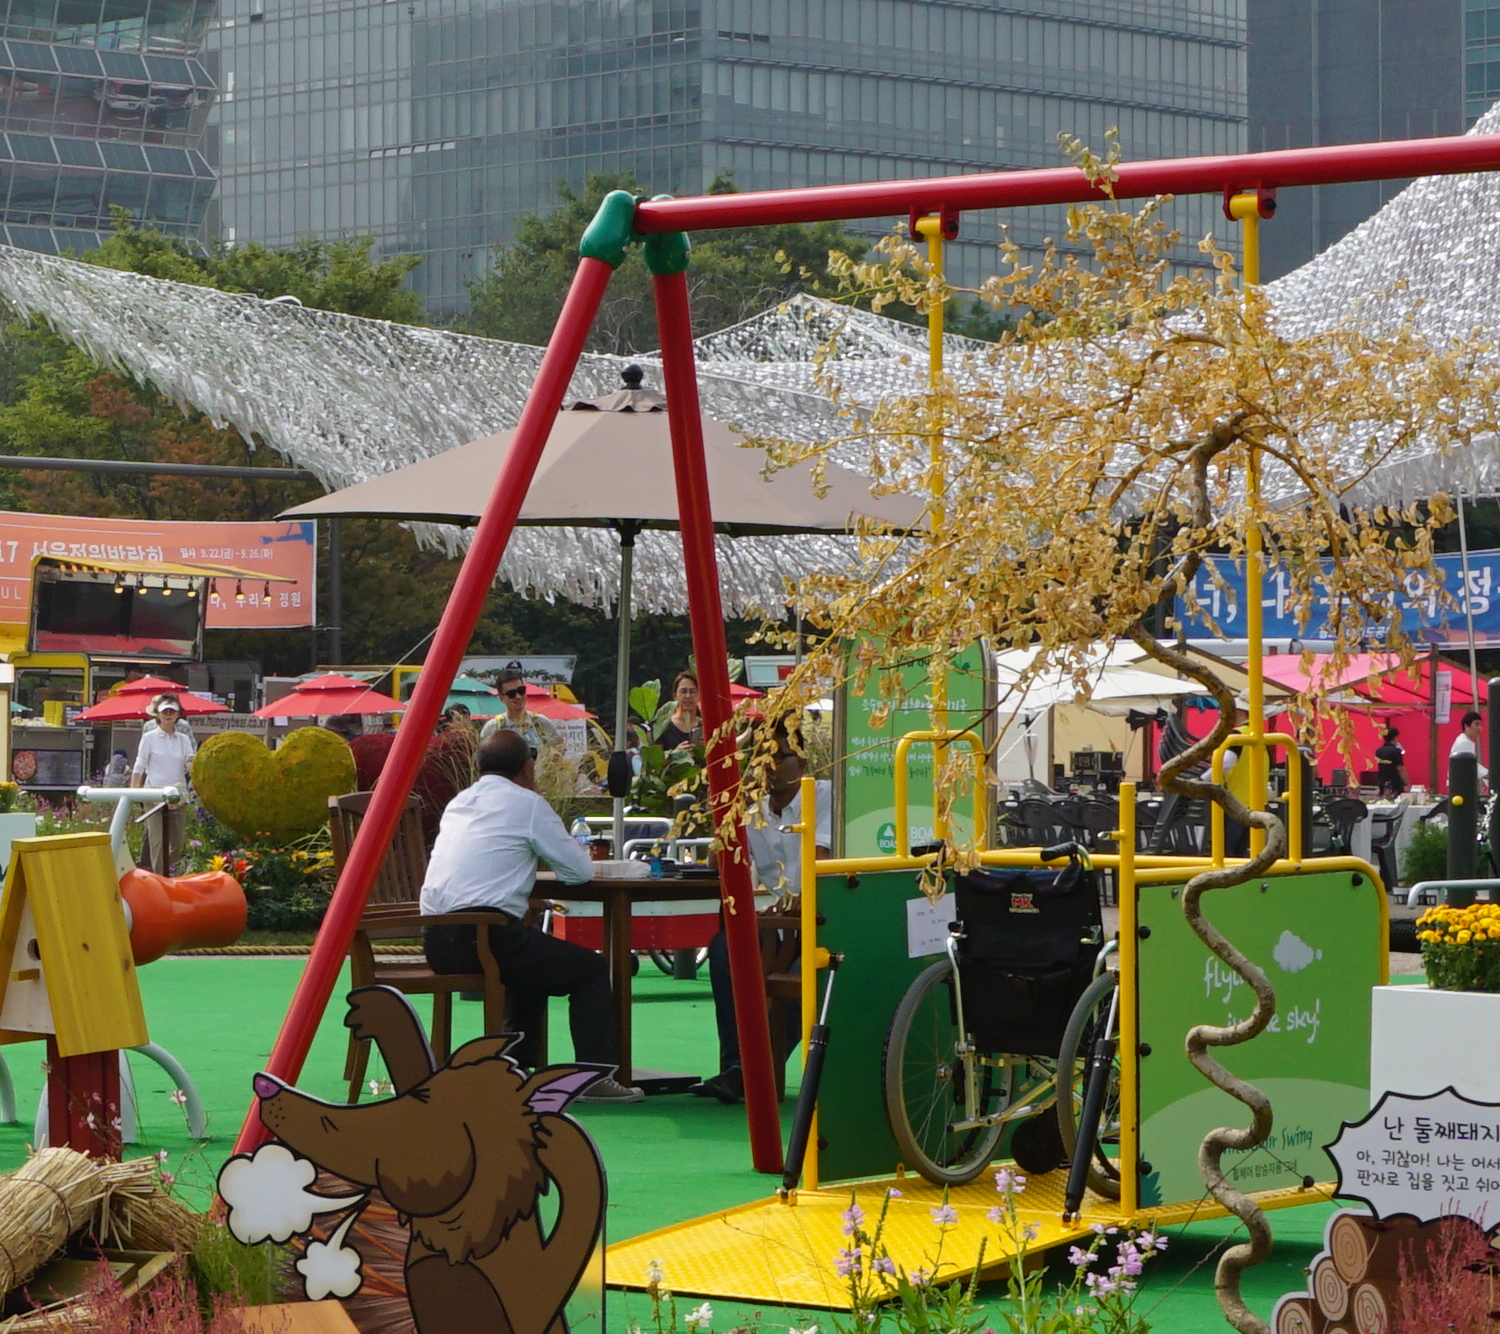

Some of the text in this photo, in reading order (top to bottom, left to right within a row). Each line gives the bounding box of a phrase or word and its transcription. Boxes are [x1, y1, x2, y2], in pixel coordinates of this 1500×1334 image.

[280, 592, 301, 607] 정원
[911, 826, 935, 840] BOA
[1286, 998, 1320, 1044] sky!
[1282, 1125, 1313, 1151] Swing
[1384, 1116, 1403, 1142] 난
[1356, 1150, 1376, 1166] 아,
[1381, 1149, 1431, 1168] 귀찮아!
[1437, 1153, 1466, 1171] 나는
[1471, 1156, 1500, 1171] 어서
[1356, 1169, 1400, 1187] 판자로
[1407, 1171, 1434, 1191] 집을
[1441, 1174, 1470, 1192] 짓고
